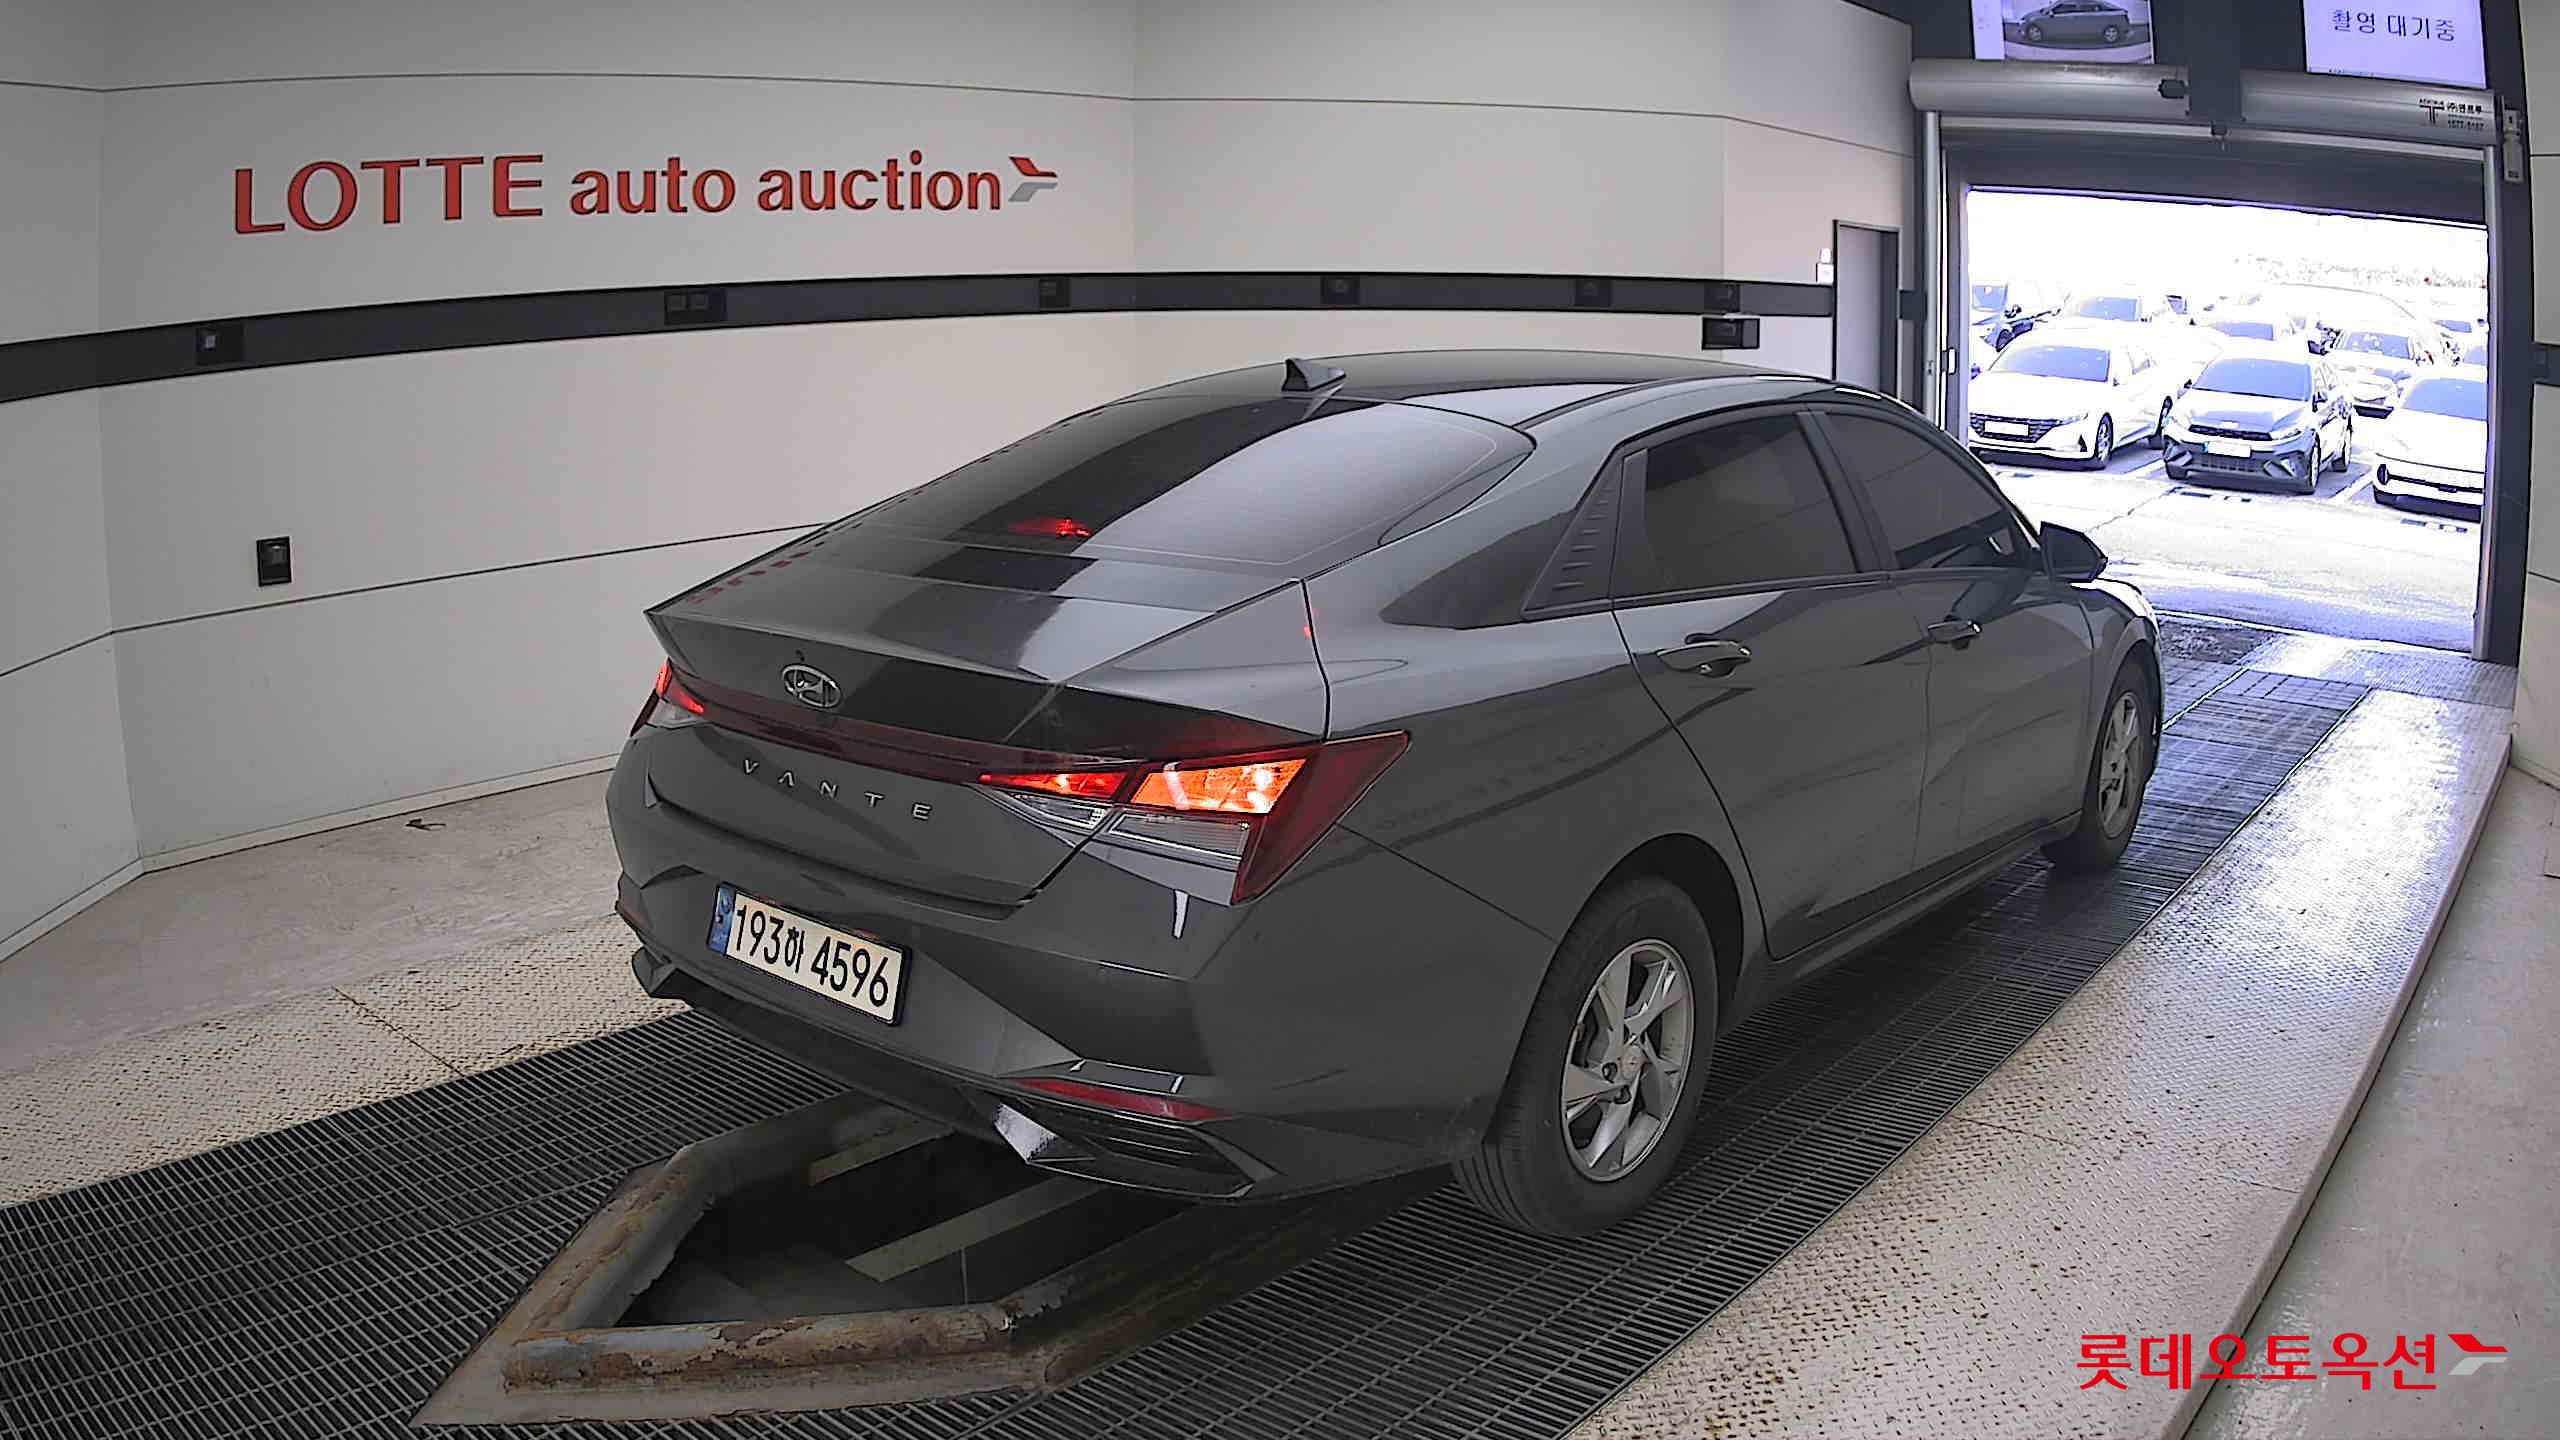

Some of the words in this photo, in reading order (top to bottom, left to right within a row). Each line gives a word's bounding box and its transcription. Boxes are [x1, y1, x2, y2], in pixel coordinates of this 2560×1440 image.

[2332, 10, 2376, 34] 촬영
[2387, 15, 2455, 42] 대기중
[235, 157, 543, 233] LOTTE
[570, 158, 736, 214] auto
[756, 150, 1002, 210] auction
[735, 904, 806, 974] 193하
[810, 936, 889, 1008] 4596
